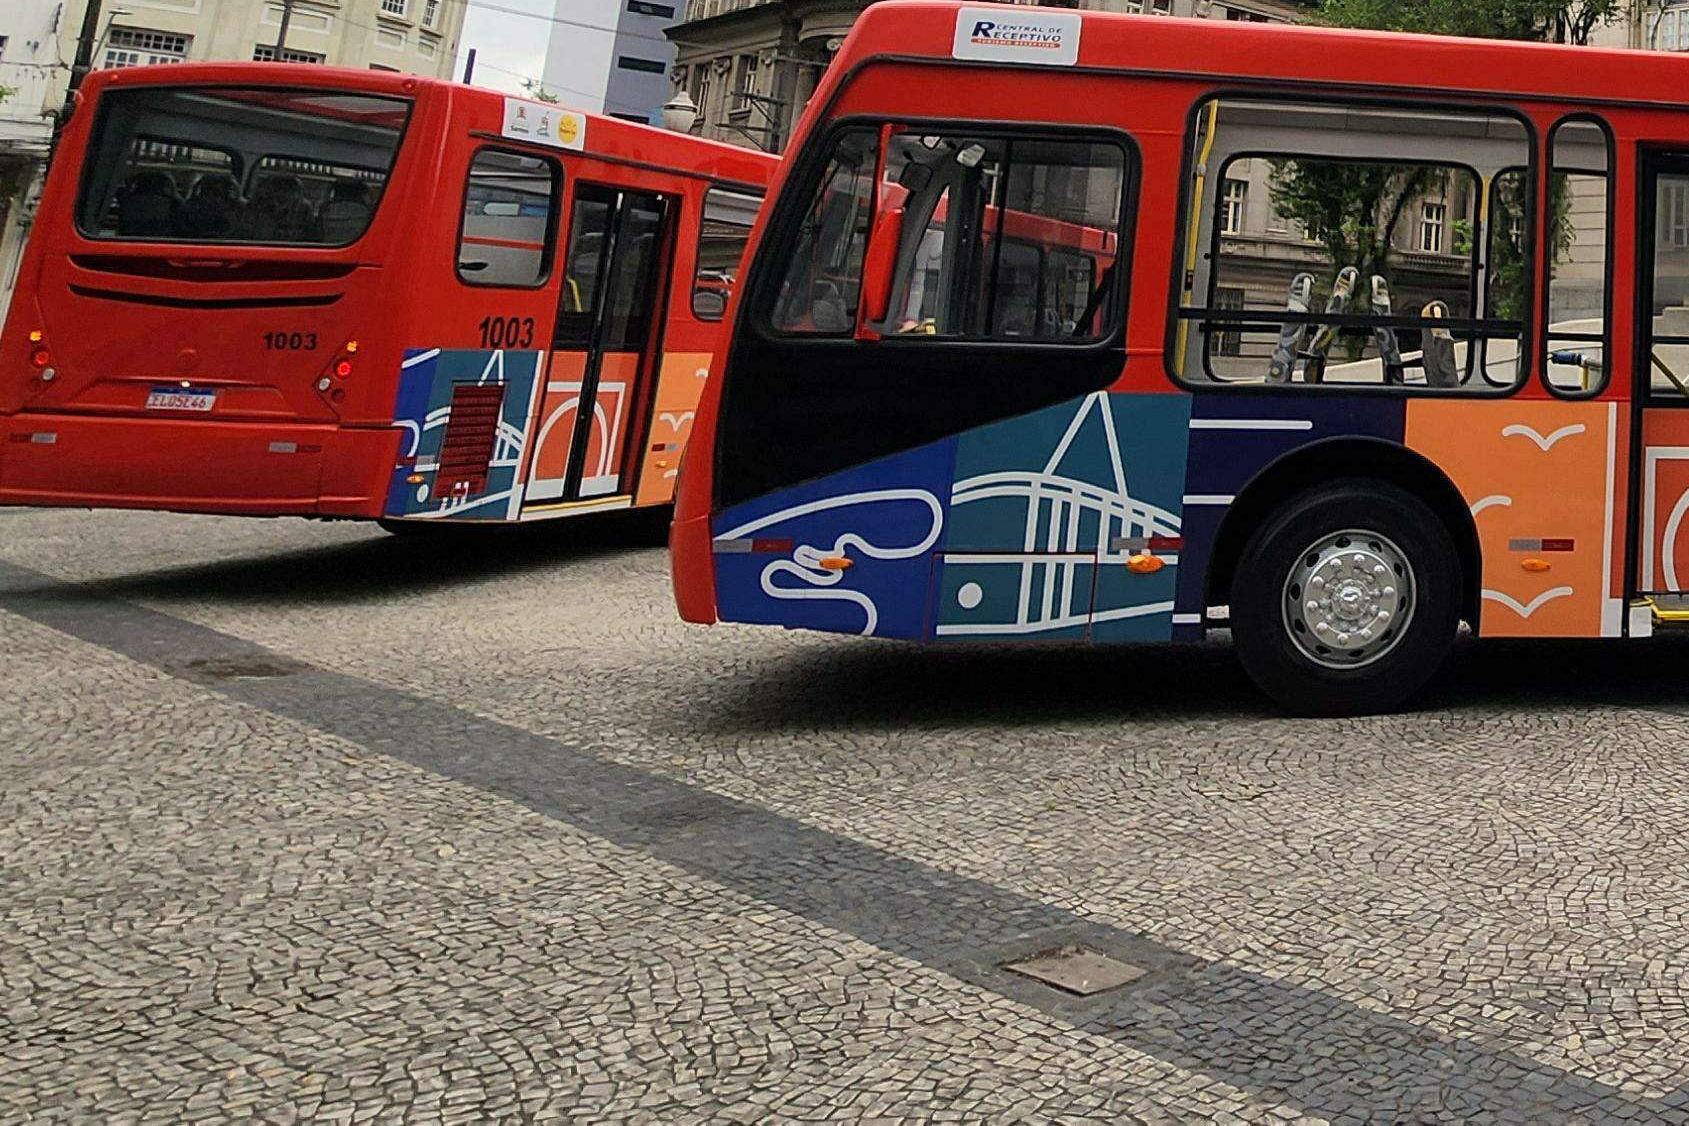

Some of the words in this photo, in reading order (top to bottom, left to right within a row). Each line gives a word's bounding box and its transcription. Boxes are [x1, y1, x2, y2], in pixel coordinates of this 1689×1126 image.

[972, 21, 1062, 43] RECEPTIVO
[997, 24, 1044, 33] CENTRAL
[263, 332, 318, 351] 1003
[478, 315, 536, 349] 1003
